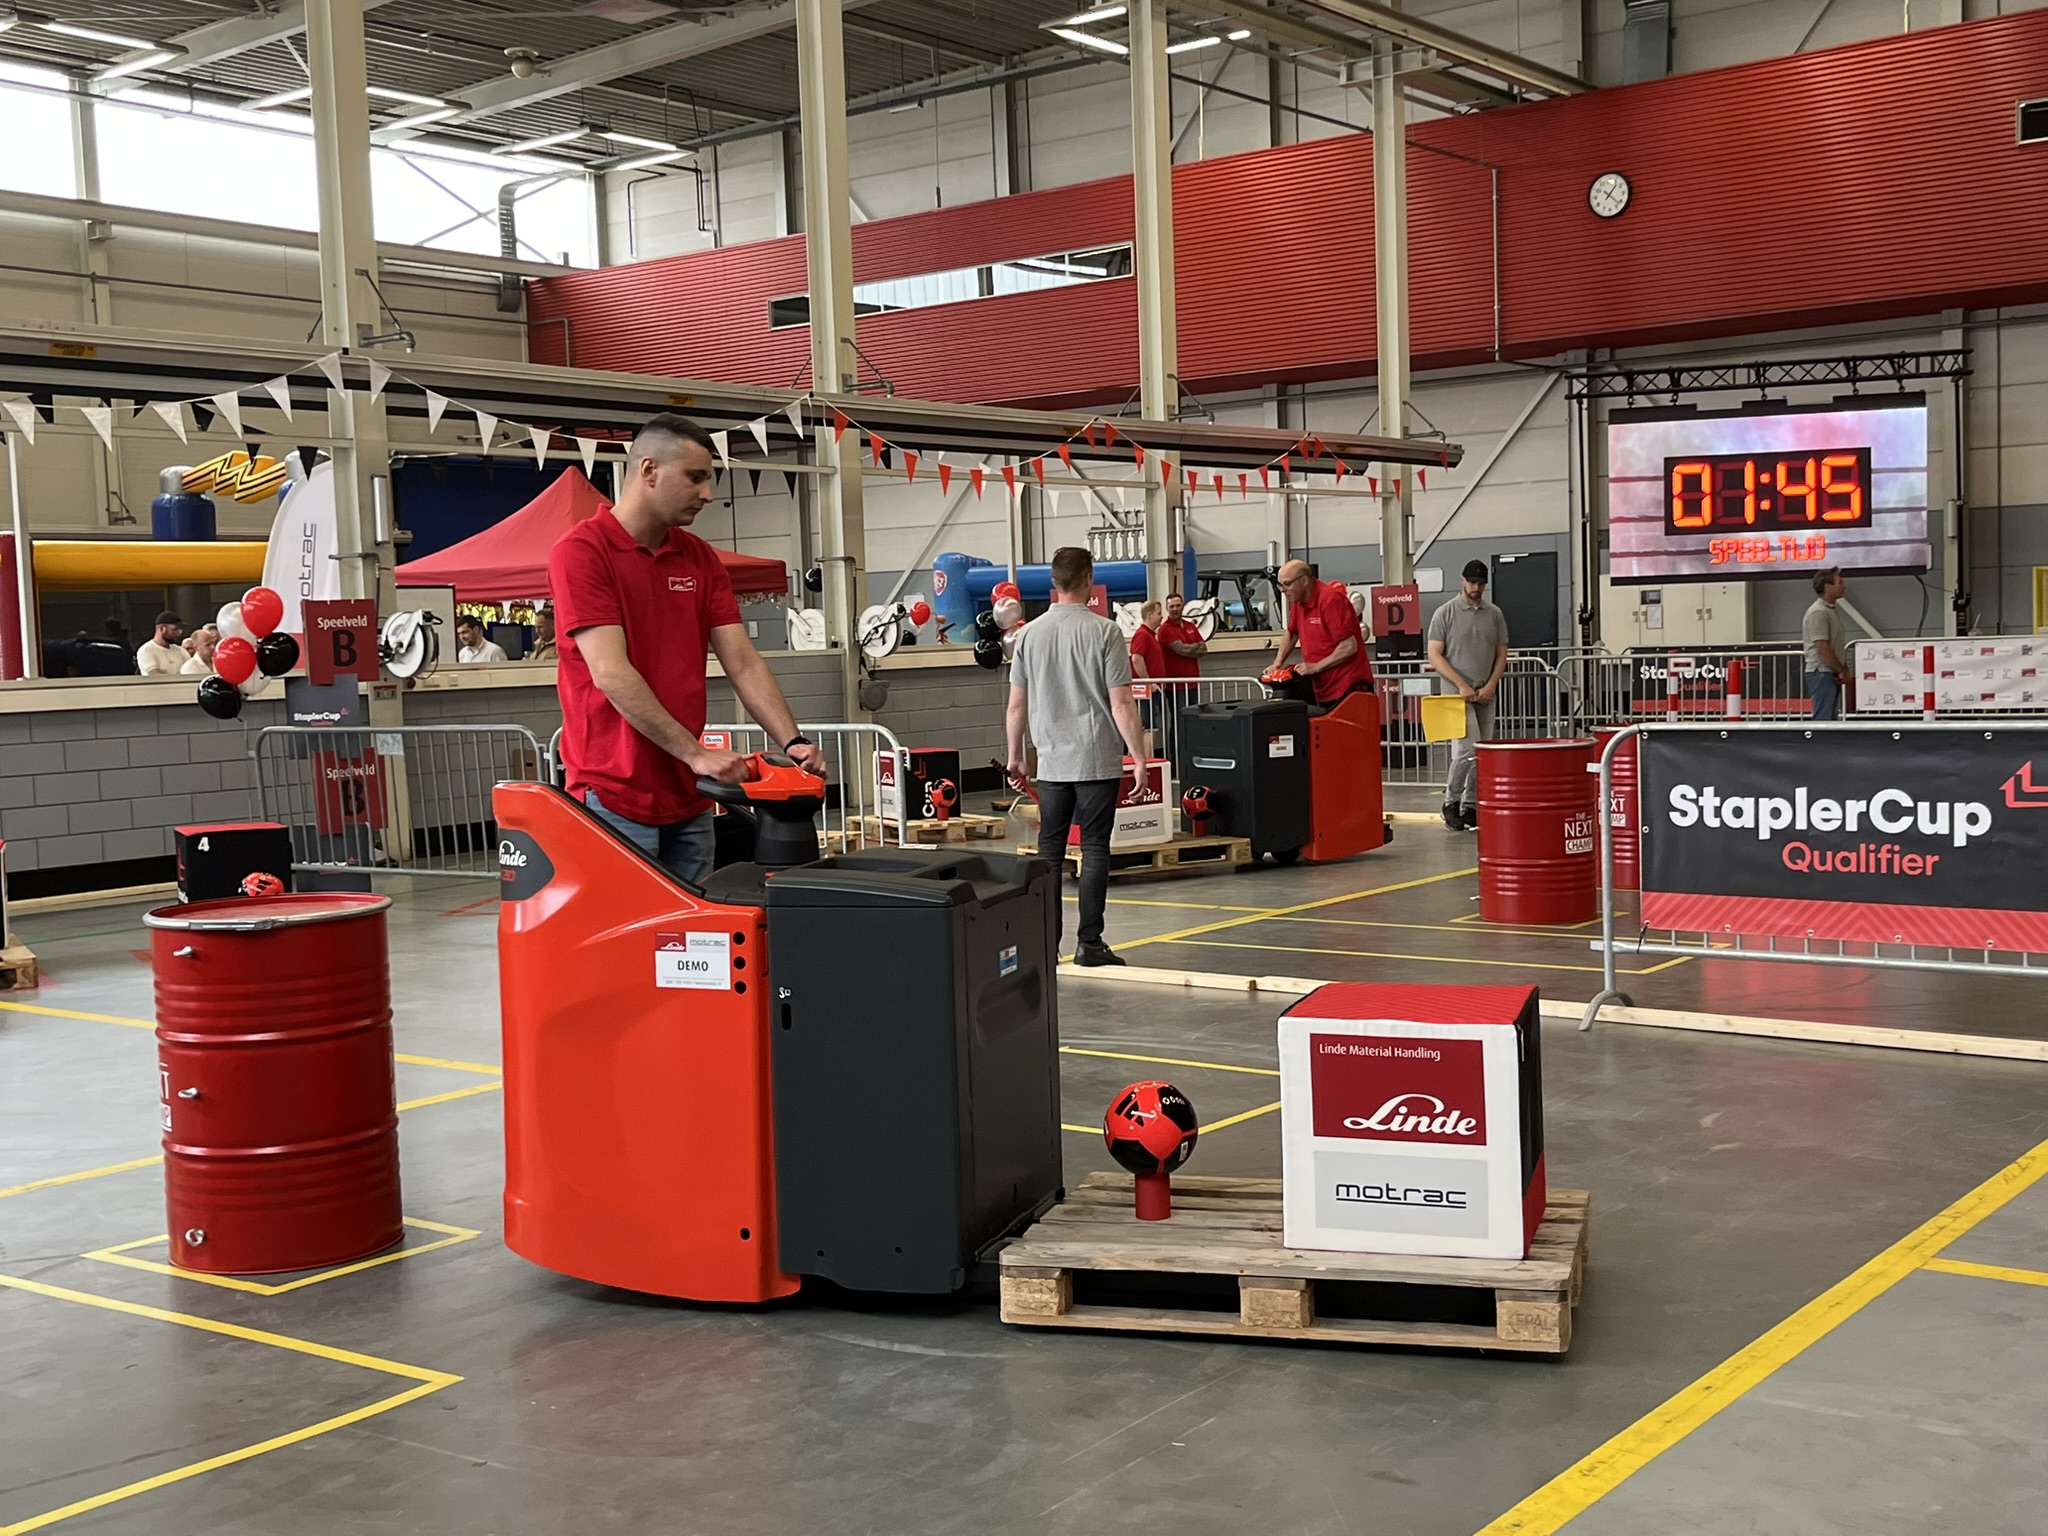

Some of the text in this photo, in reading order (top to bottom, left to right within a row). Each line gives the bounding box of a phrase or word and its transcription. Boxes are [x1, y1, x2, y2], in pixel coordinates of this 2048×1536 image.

[1672, 454, 1862, 528] 01:45
[299, 522, 317, 601] otrac
[1378, 593, 1413, 605] Speelveld
[317, 614, 368, 630] Speelveld
[1387, 603, 1405, 626] D
[331, 629, 357, 667] B
[341, 778, 366, 817] B
[1119, 819, 1159, 832] motrac
[1575, 812, 1587, 821] THE
[1668, 784, 1992, 848] StaplerCup
[1564, 819, 1593, 838] NEXT
[197, 836, 210, 852] 4
[1566, 838, 1594, 852] CHAMP
[1782, 841, 1940, 876] Qualifier
[677, 960, 709, 972] DEMO
[1319, 1043, 1441, 1062] Linde Material Handling
[1343, 1093, 1477, 1136] Linde
[1335, 1183, 1467, 1209] motrac
